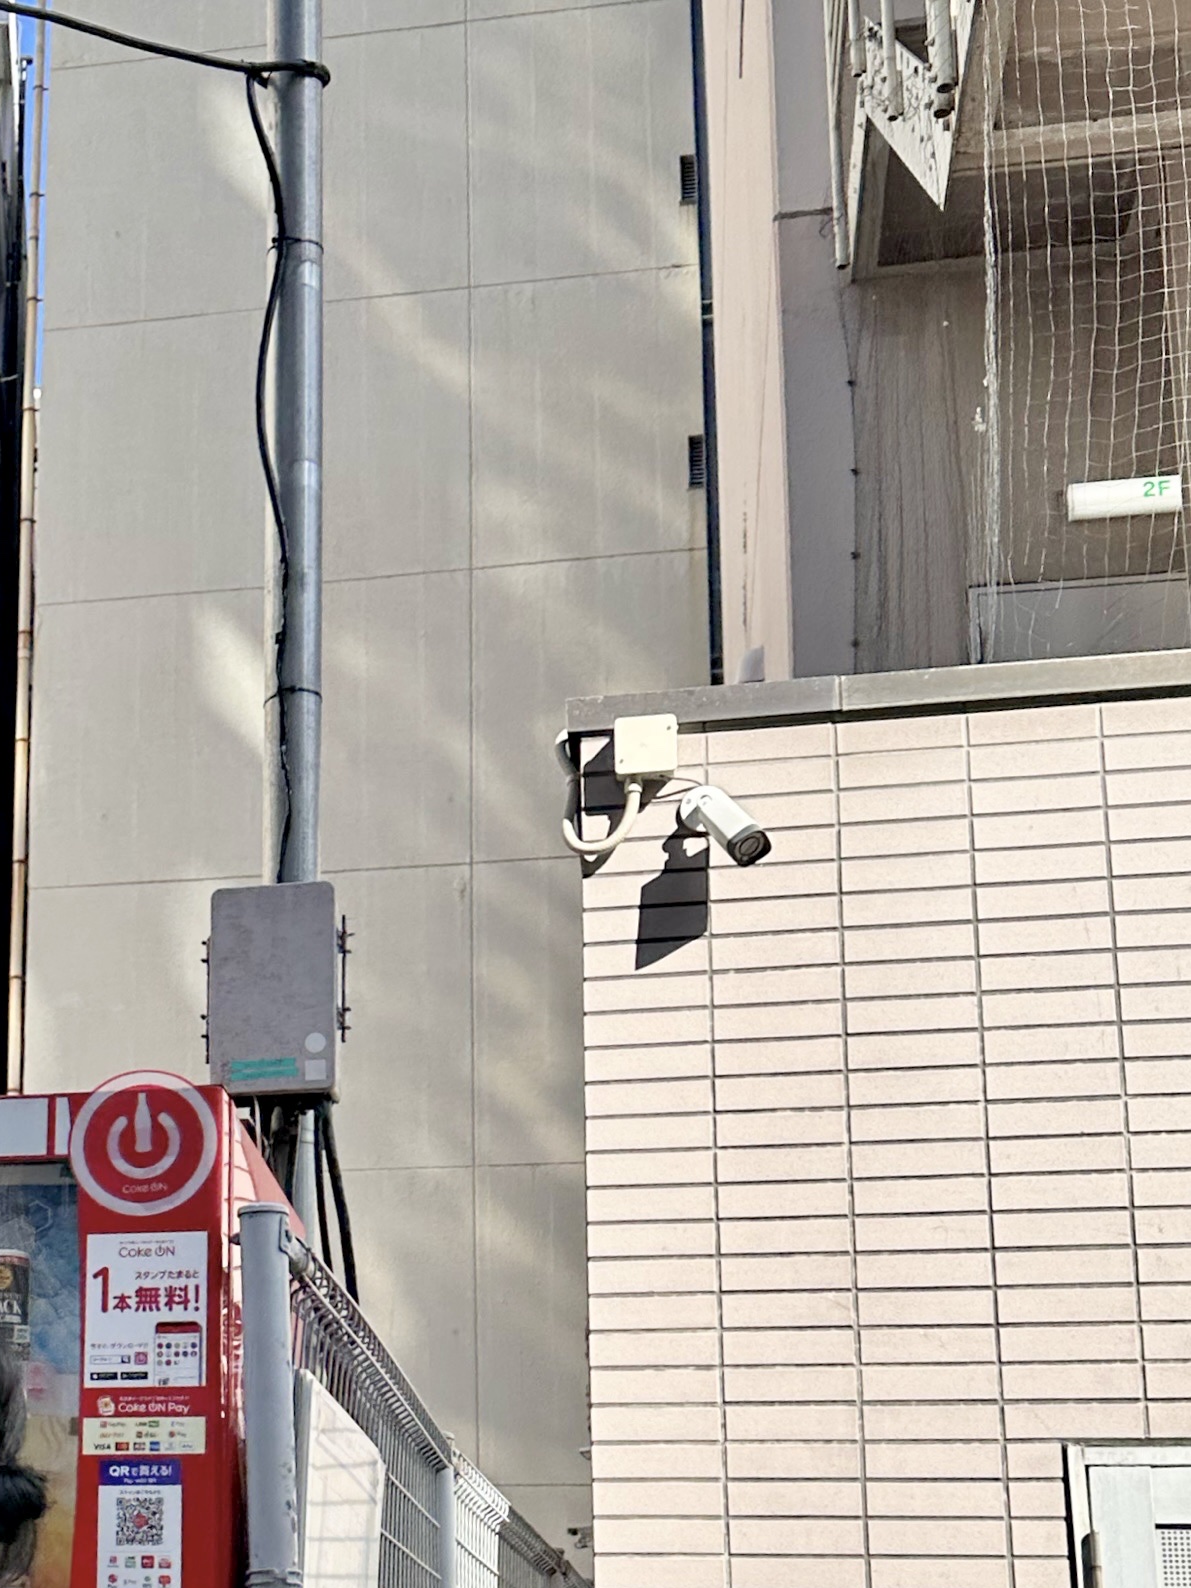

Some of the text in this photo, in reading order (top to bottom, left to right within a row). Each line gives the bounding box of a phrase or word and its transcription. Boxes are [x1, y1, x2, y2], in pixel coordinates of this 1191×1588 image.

[1143, 480, 1170, 497] 2F
[118, 1244, 176, 1258] Coke ON
[135, 1270, 200, 1280] スタンプたまると
[92, 1266, 201, 1313] 1本無料!
[117, 1401, 190, 1414] Coke ON Pay
[109, 1465, 172, 1477] QRで買える!
